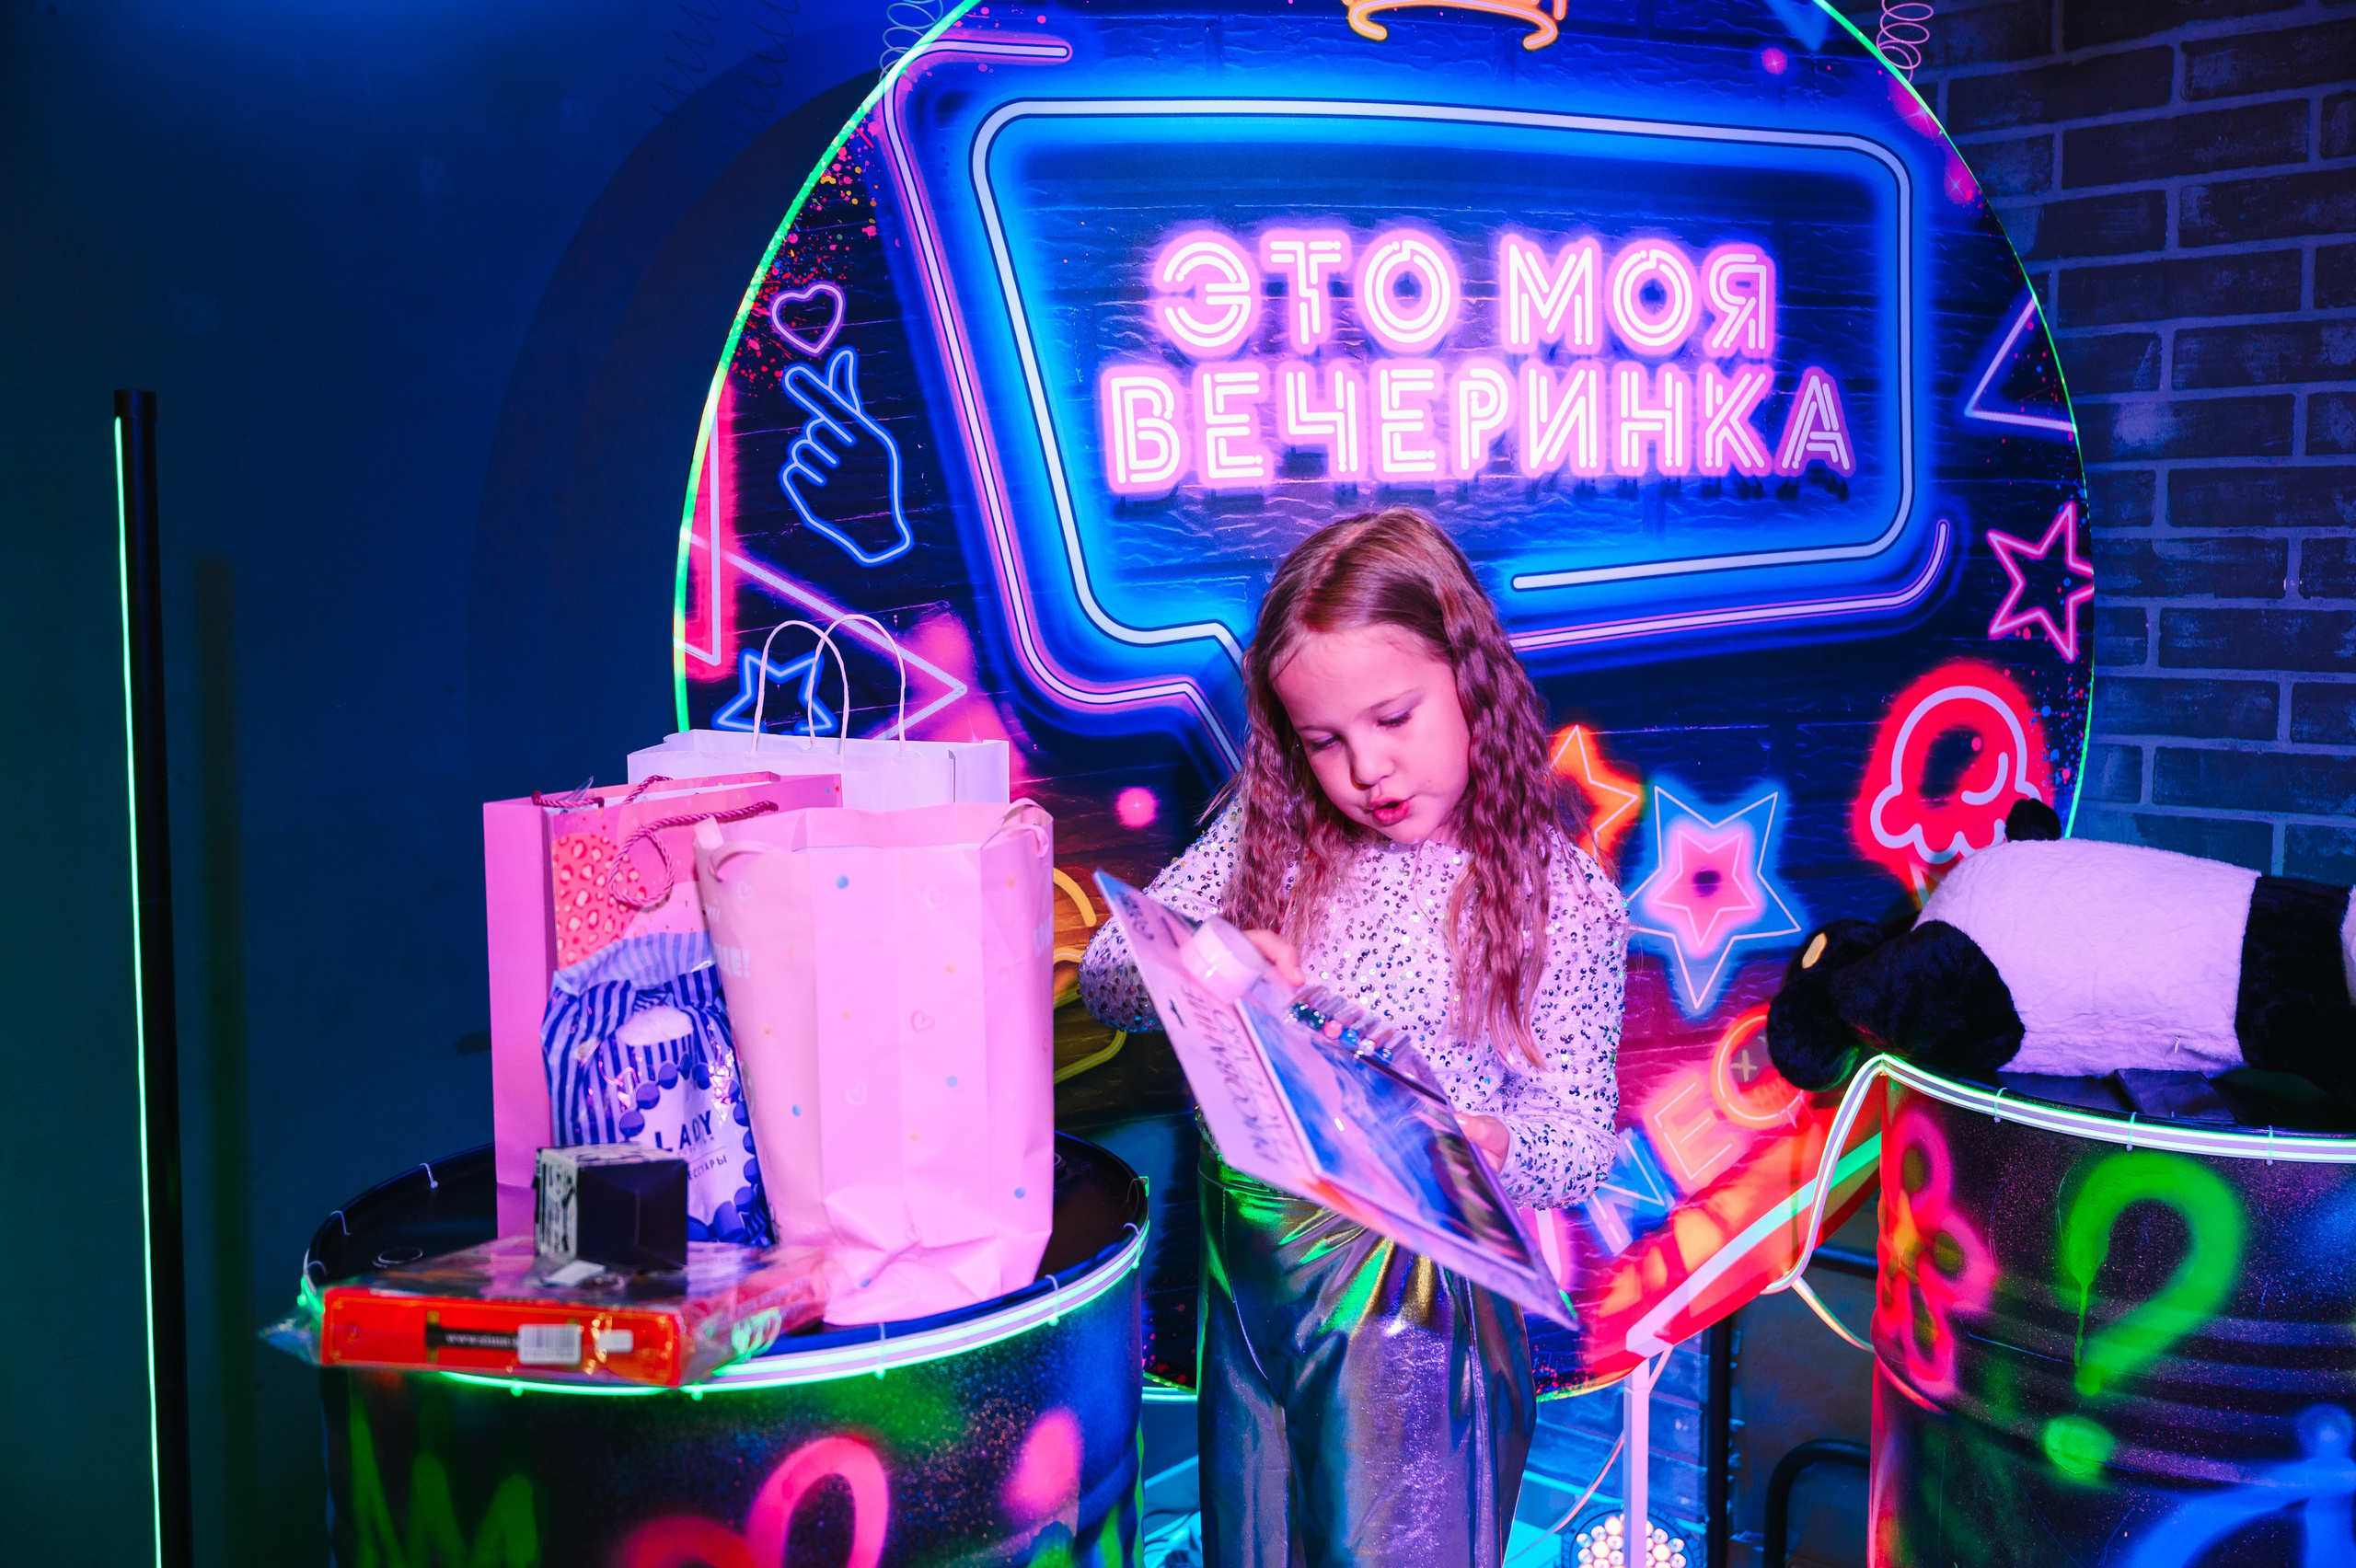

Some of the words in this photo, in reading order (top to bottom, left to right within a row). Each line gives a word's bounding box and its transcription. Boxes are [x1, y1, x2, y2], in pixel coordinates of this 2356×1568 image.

[1152, 228, 1461, 357] ЭТО
[1499, 233, 1777, 359] МОЯ
[1103, 360, 1856, 493] ВЕЧЕРИНКА
[654, 1109, 713, 1153] LADY
